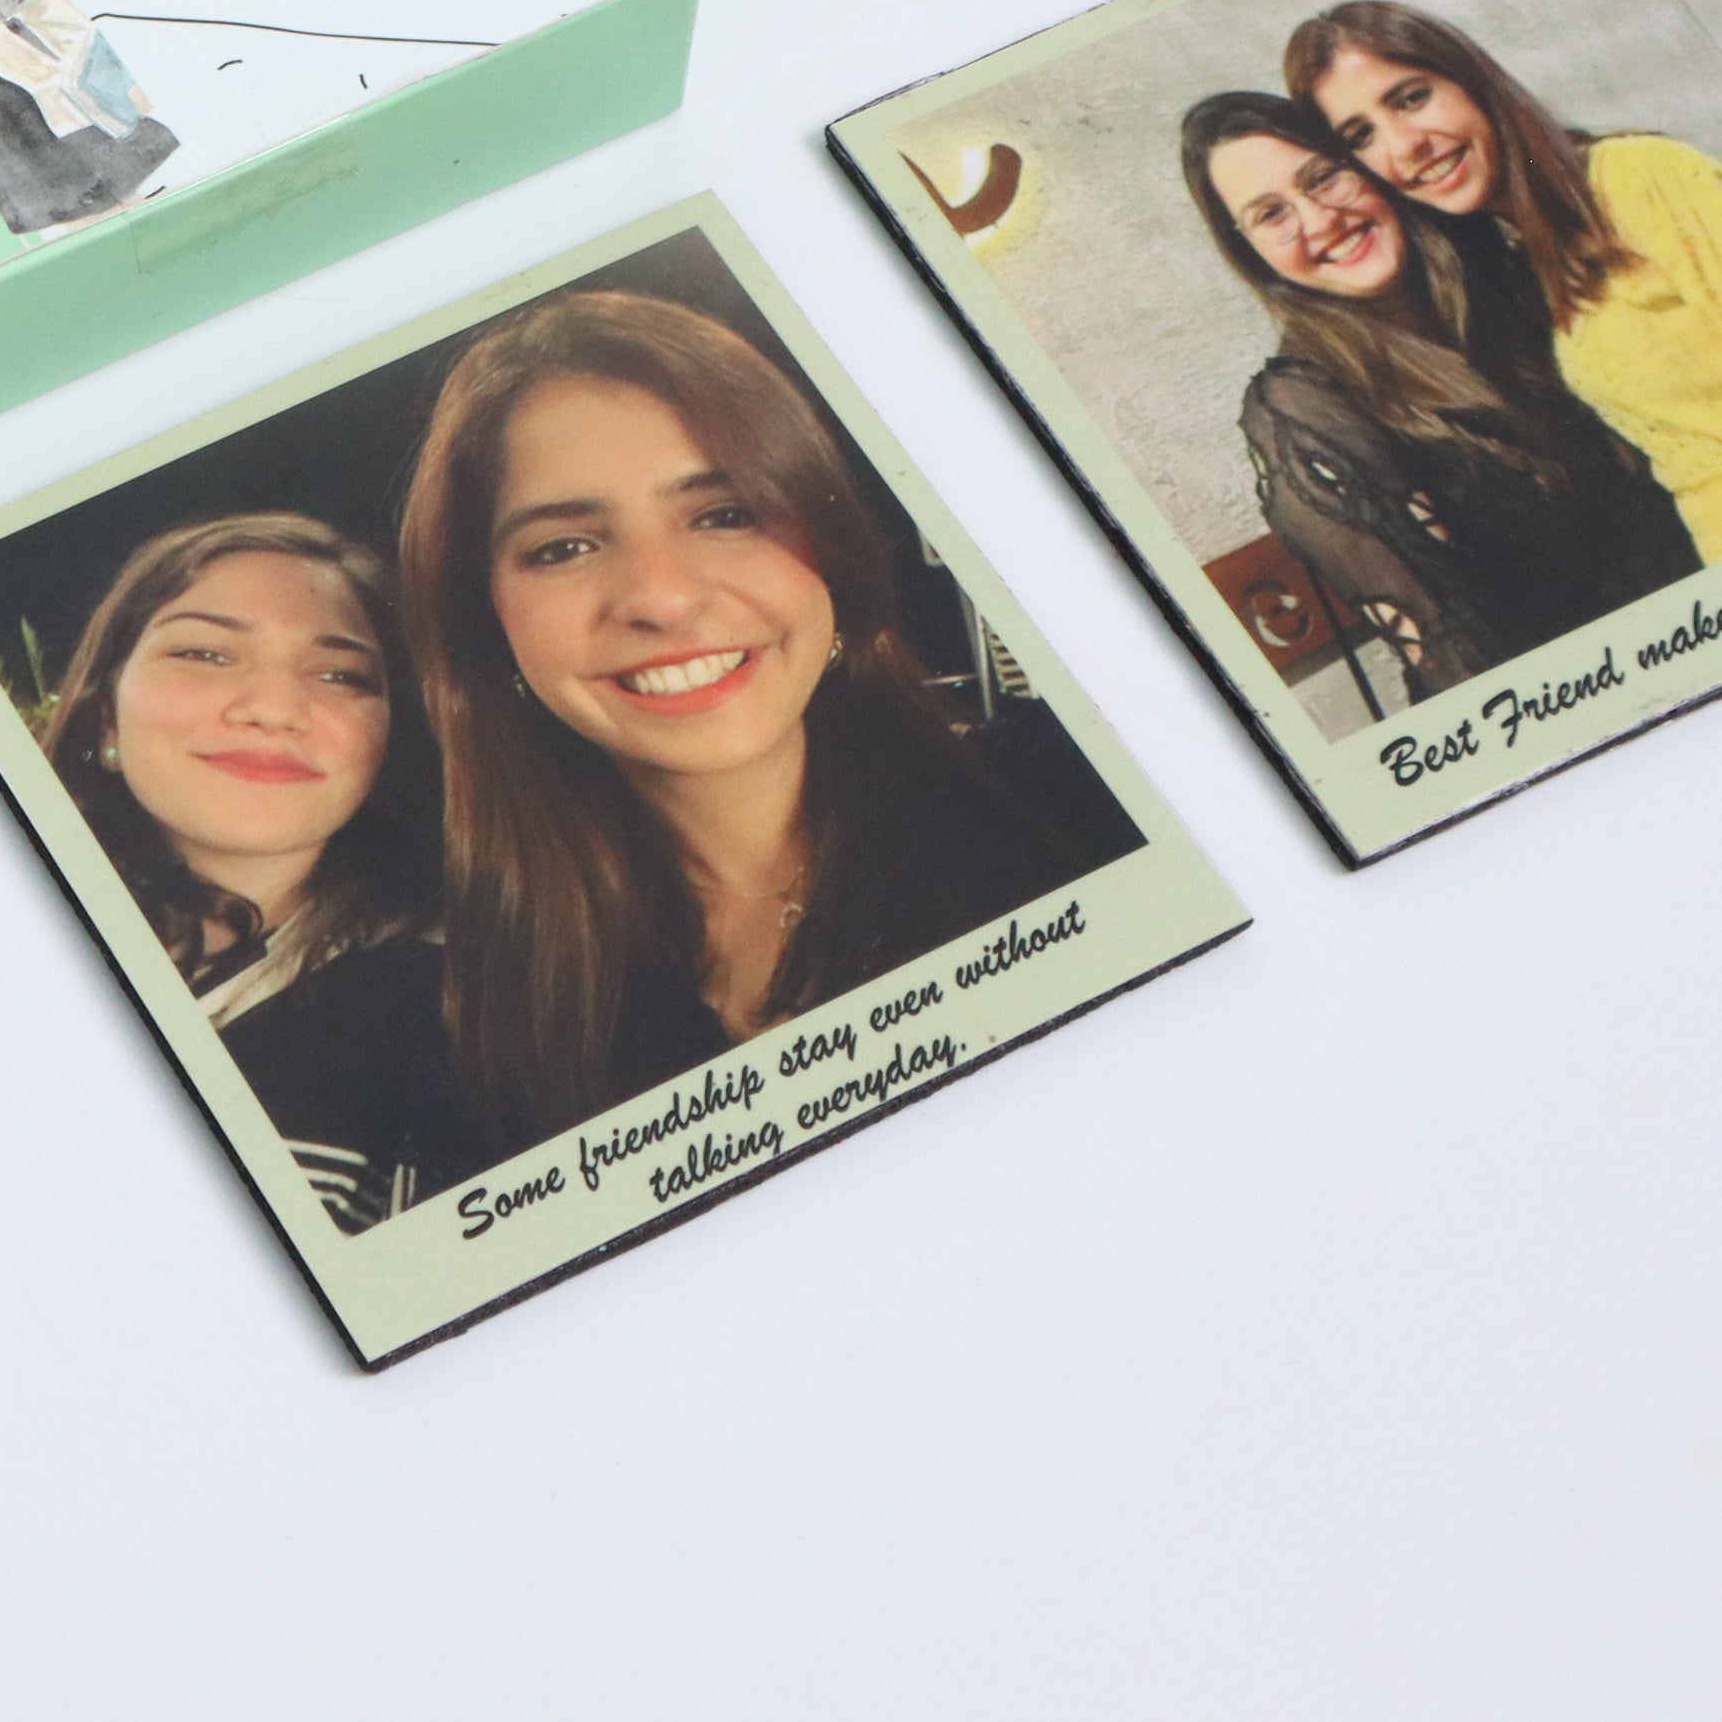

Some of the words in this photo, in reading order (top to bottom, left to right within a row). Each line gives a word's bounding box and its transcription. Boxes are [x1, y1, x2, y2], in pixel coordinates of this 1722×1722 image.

[1380, 719, 1479, 787] Best
[1482, 646, 1625, 749] Friend
[458, 1167, 566, 1240] Some
[579, 1064, 764, 1191] friendship
[779, 1023, 858, 1078] stay
[870, 982, 944, 1033] even
[955, 900, 1086, 990] without
[649, 1118, 785, 1204] talking
[796, 1034, 968, 1131] everyday.
